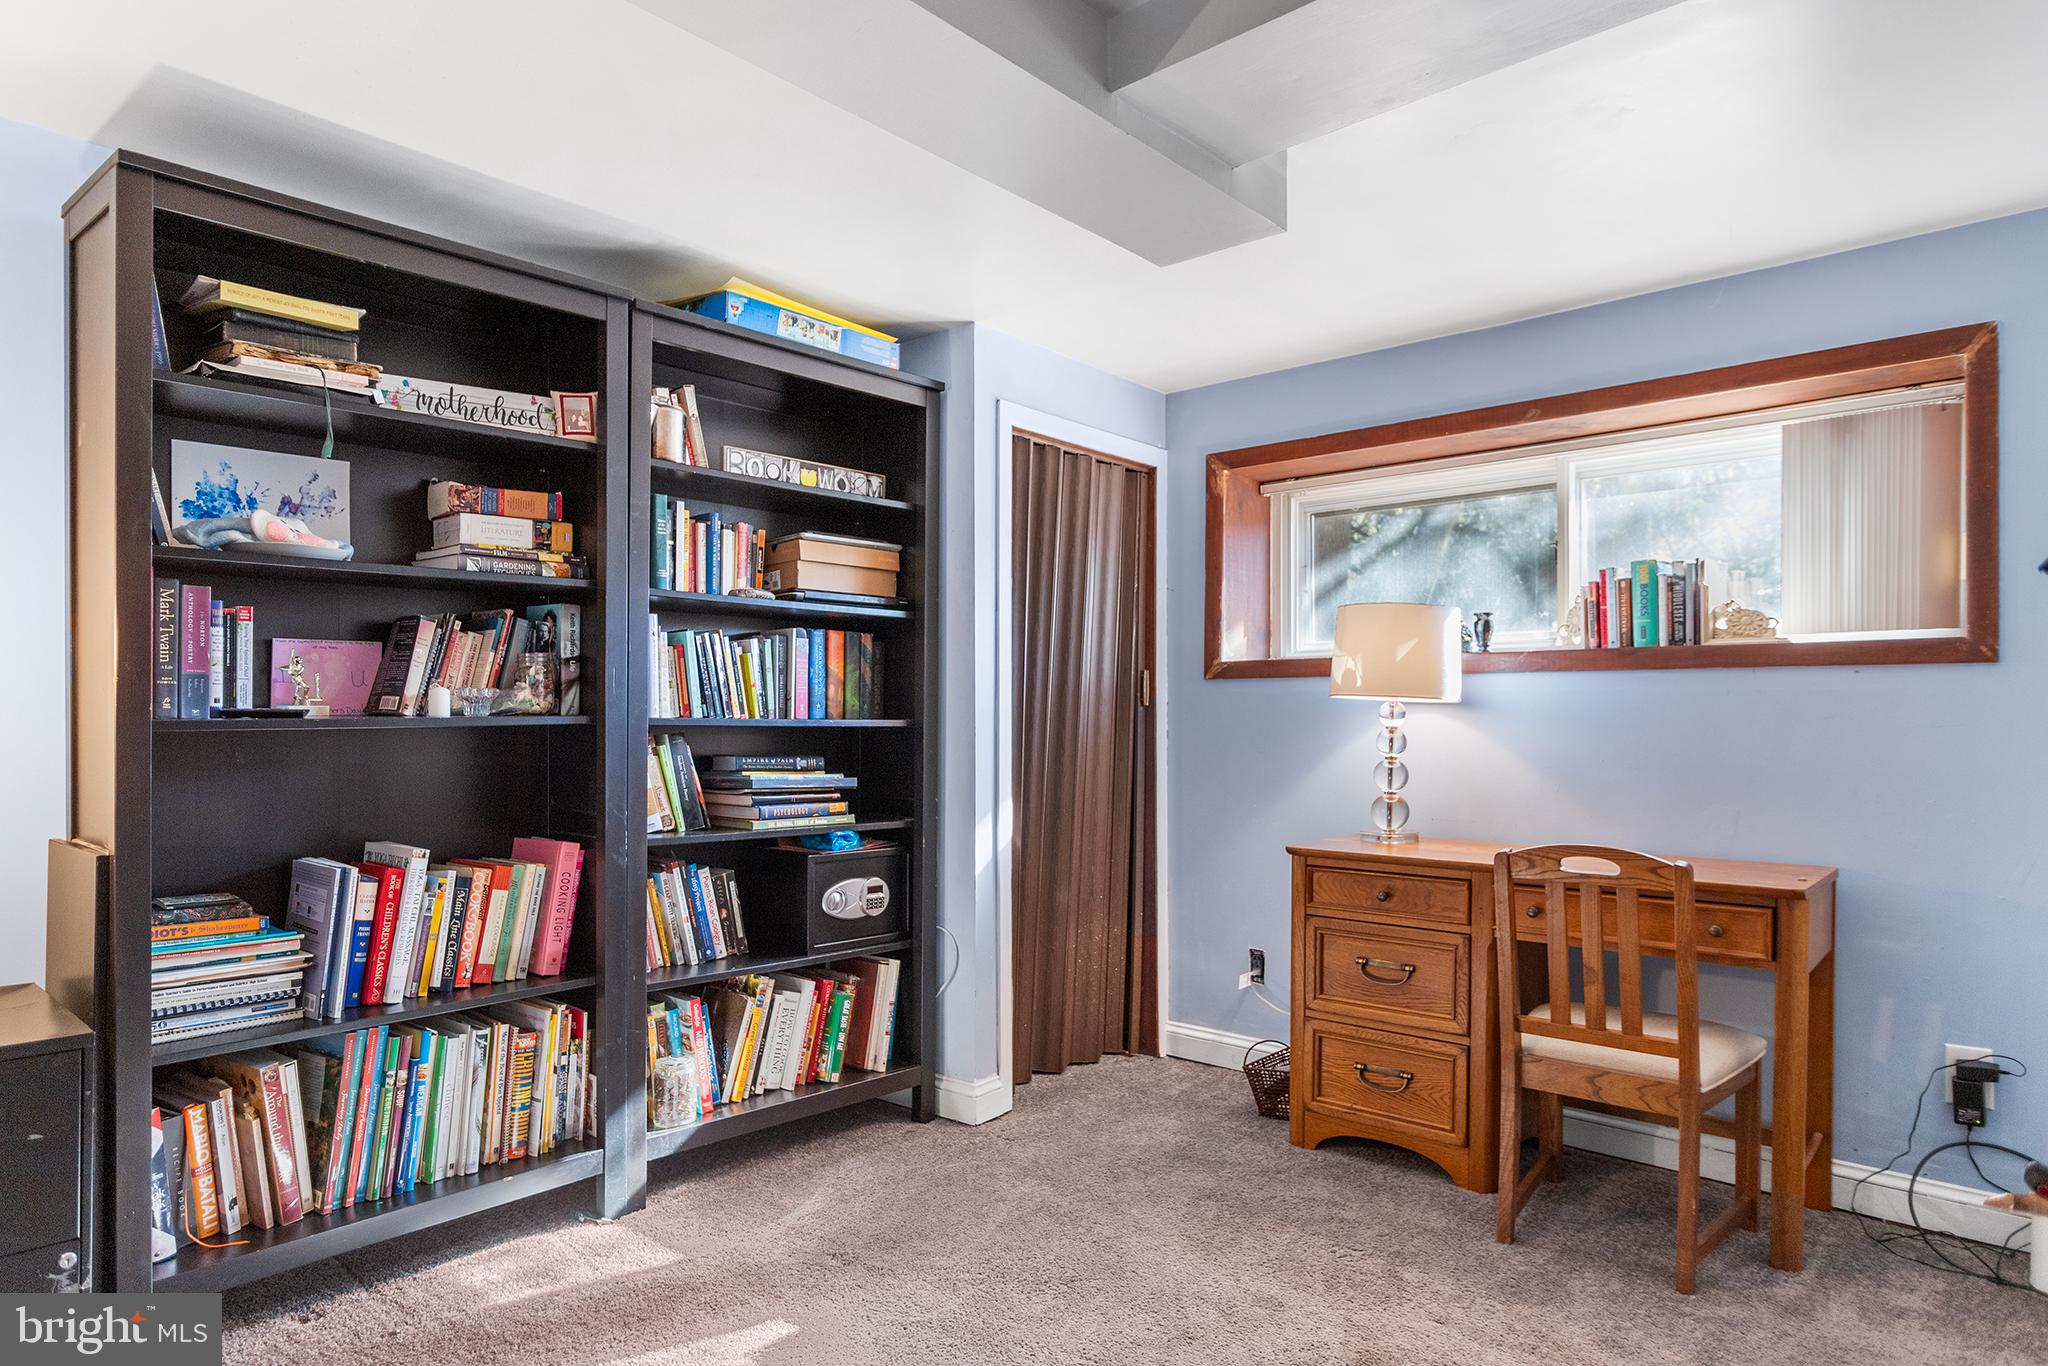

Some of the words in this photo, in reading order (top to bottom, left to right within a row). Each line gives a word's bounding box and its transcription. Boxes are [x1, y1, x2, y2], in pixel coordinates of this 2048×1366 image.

[413, 386, 549, 430] motherhood
[726, 447, 800, 485] BOOK
[817, 467, 884, 498] WORM
[480, 525, 524, 537] LITERATURE
[493, 561, 536, 570] GARDENING
[160, 588, 174, 621] Mark
[1640, 584, 1648, 616] BOOKS
[1673, 584, 1683, 623] MIDDLESEX
[160, 625, 174, 662] Twain
[679, 771, 687, 788] American
[773, 807, 808, 816] PSYCHOLOGY
[389, 875, 397, 890] BOOK
[415, 867, 425, 890] YOGA,
[690, 877, 700, 892] 1619
[702, 875, 712, 899] Puerto
[453, 890, 466, 917] Main
[556, 872, 571, 913] COOKING
[693, 892, 704, 913] Project
[707, 900, 716, 918] Rican
[379, 902, 395, 951] CHILDREN'S
[448, 918, 461, 939] Line
[552, 917, 564, 943] LIGHT
[710, 919, 722, 946] Cookery
[401, 926, 414, 966] MASSAGE,
[444, 940, 457, 977] Classics
[373, 951, 387, 987] CLASSICS
[787, 1009, 795, 1031] HOW
[842, 1000, 851, 1014] GREAT
[748, 1022, 759, 1043] Greek
[840, 1015, 848, 1028] TASTE
[693, 1031, 704, 1049] MAD
[770, 1007, 789, 1075] EVERYTHING
[783, 1033, 790, 1046] TO
[742, 1044, 754, 1072] Cooking
[777, 1047, 787, 1074] COOK
[512, 1051, 534, 1109] GRILLING
[266, 1087, 280, 1132] Around
[275, 1094, 284, 1107] The
[395, 1089, 404, 1108] SOUP
[415, 1085, 425, 1116] MEXICAN
[381, 1091, 393, 1136] VEGETARIAN
[509, 1109, 529, 1141] BOOK
[190, 1109, 210, 1162] MARIO
[172, 1147, 182, 1182] RECIPE
[198, 1177, 217, 1228] BATALI
